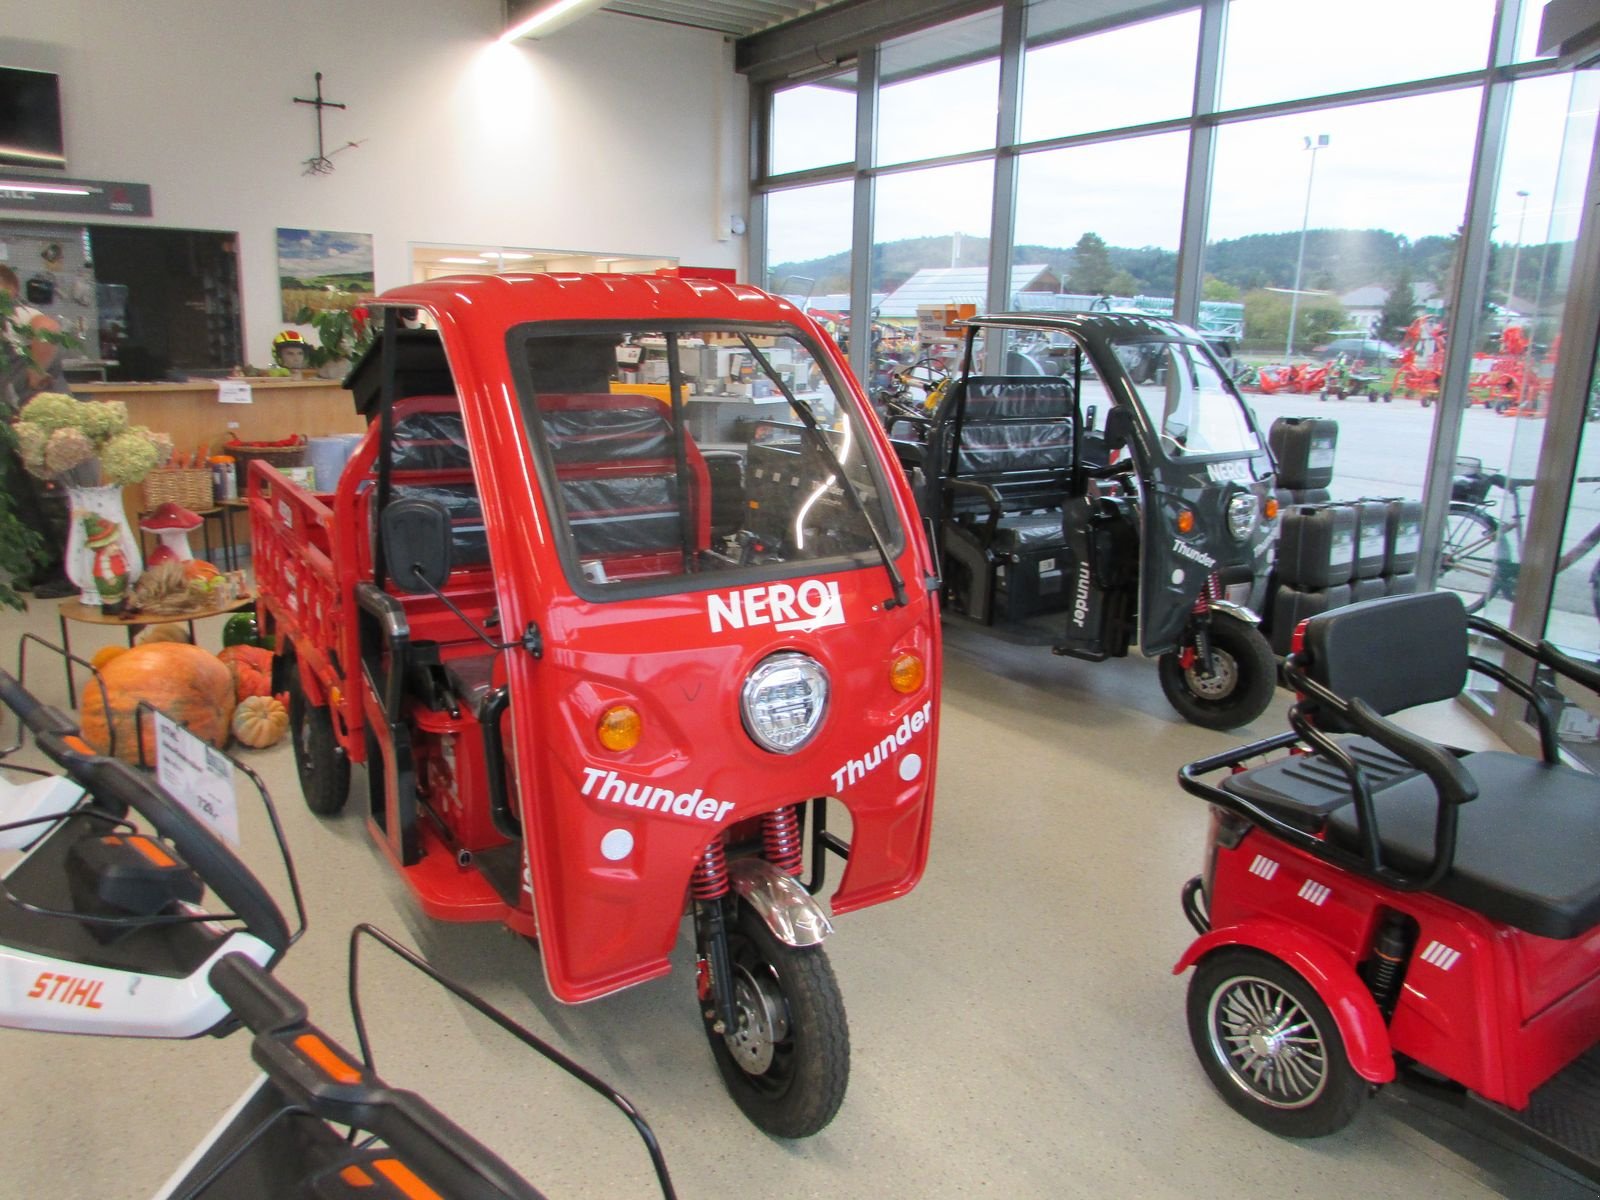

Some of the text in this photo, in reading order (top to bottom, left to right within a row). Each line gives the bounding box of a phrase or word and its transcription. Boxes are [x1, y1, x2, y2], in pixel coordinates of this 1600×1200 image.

[1172, 539, 1216, 568] Thunder
[706, 580, 835, 632] NERO
[831, 700, 933, 793] Thunder
[580, 766, 736, 823] Thunder
[27, 972, 105, 1010] STIHL
